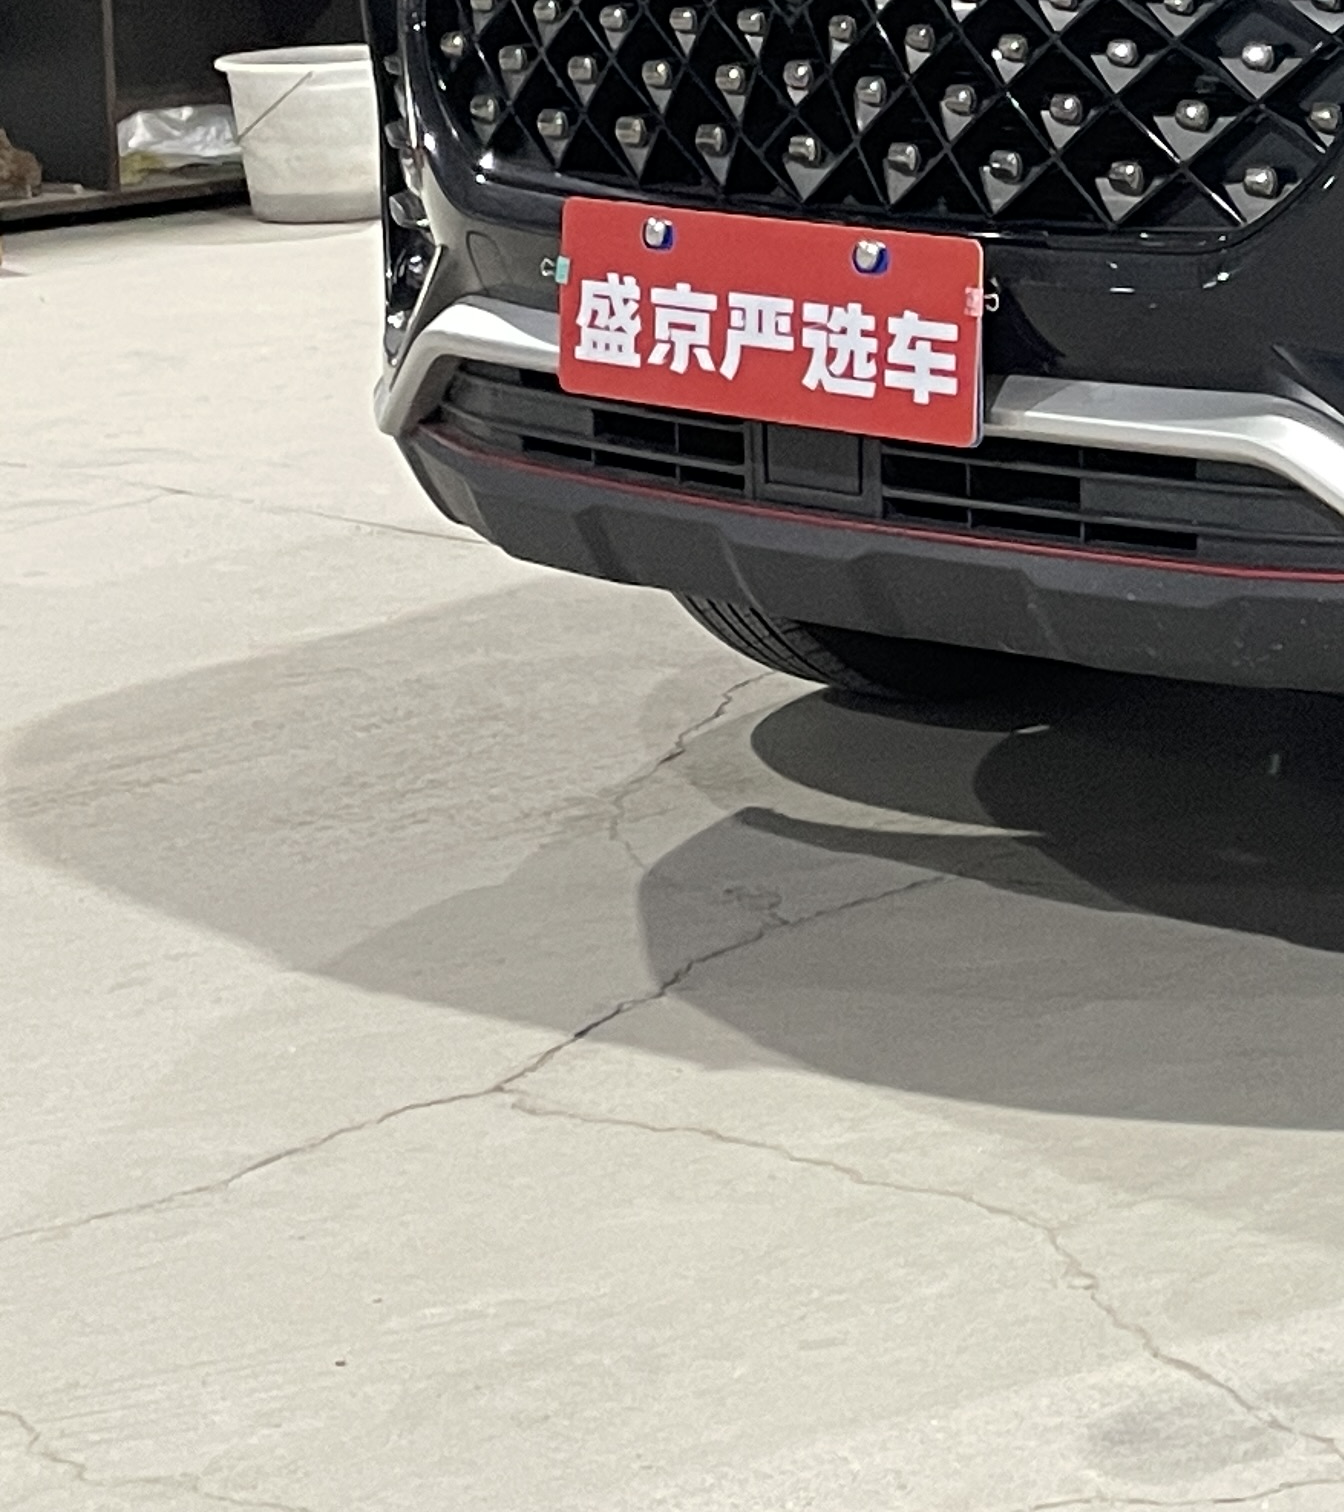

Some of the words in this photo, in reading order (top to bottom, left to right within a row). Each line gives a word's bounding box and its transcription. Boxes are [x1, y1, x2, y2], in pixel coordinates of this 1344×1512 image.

[574, 272, 960, 405] 盛京严选车
